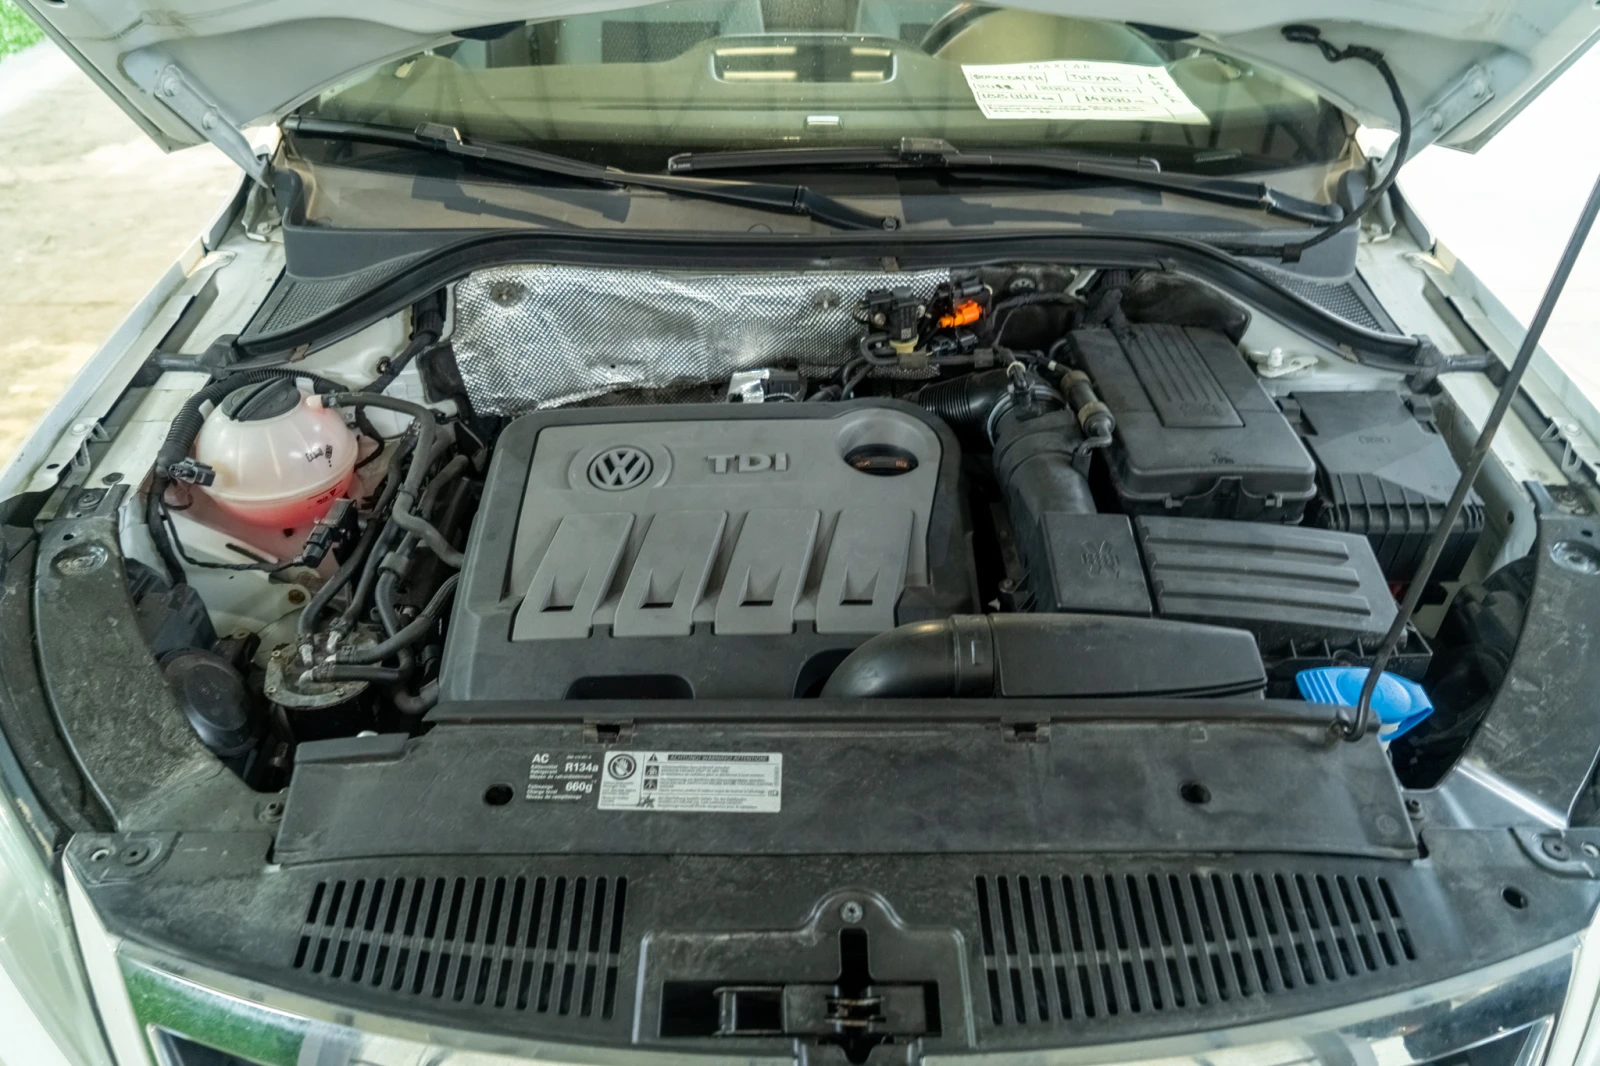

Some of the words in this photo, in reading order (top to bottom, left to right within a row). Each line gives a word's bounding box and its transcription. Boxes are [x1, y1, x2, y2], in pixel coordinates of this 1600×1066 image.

[706, 451, 790, 474] TDI
[532, 753, 550, 764] AC
[565, 762, 599, 772] R134a
[565, 782, 593, 793] 660g
